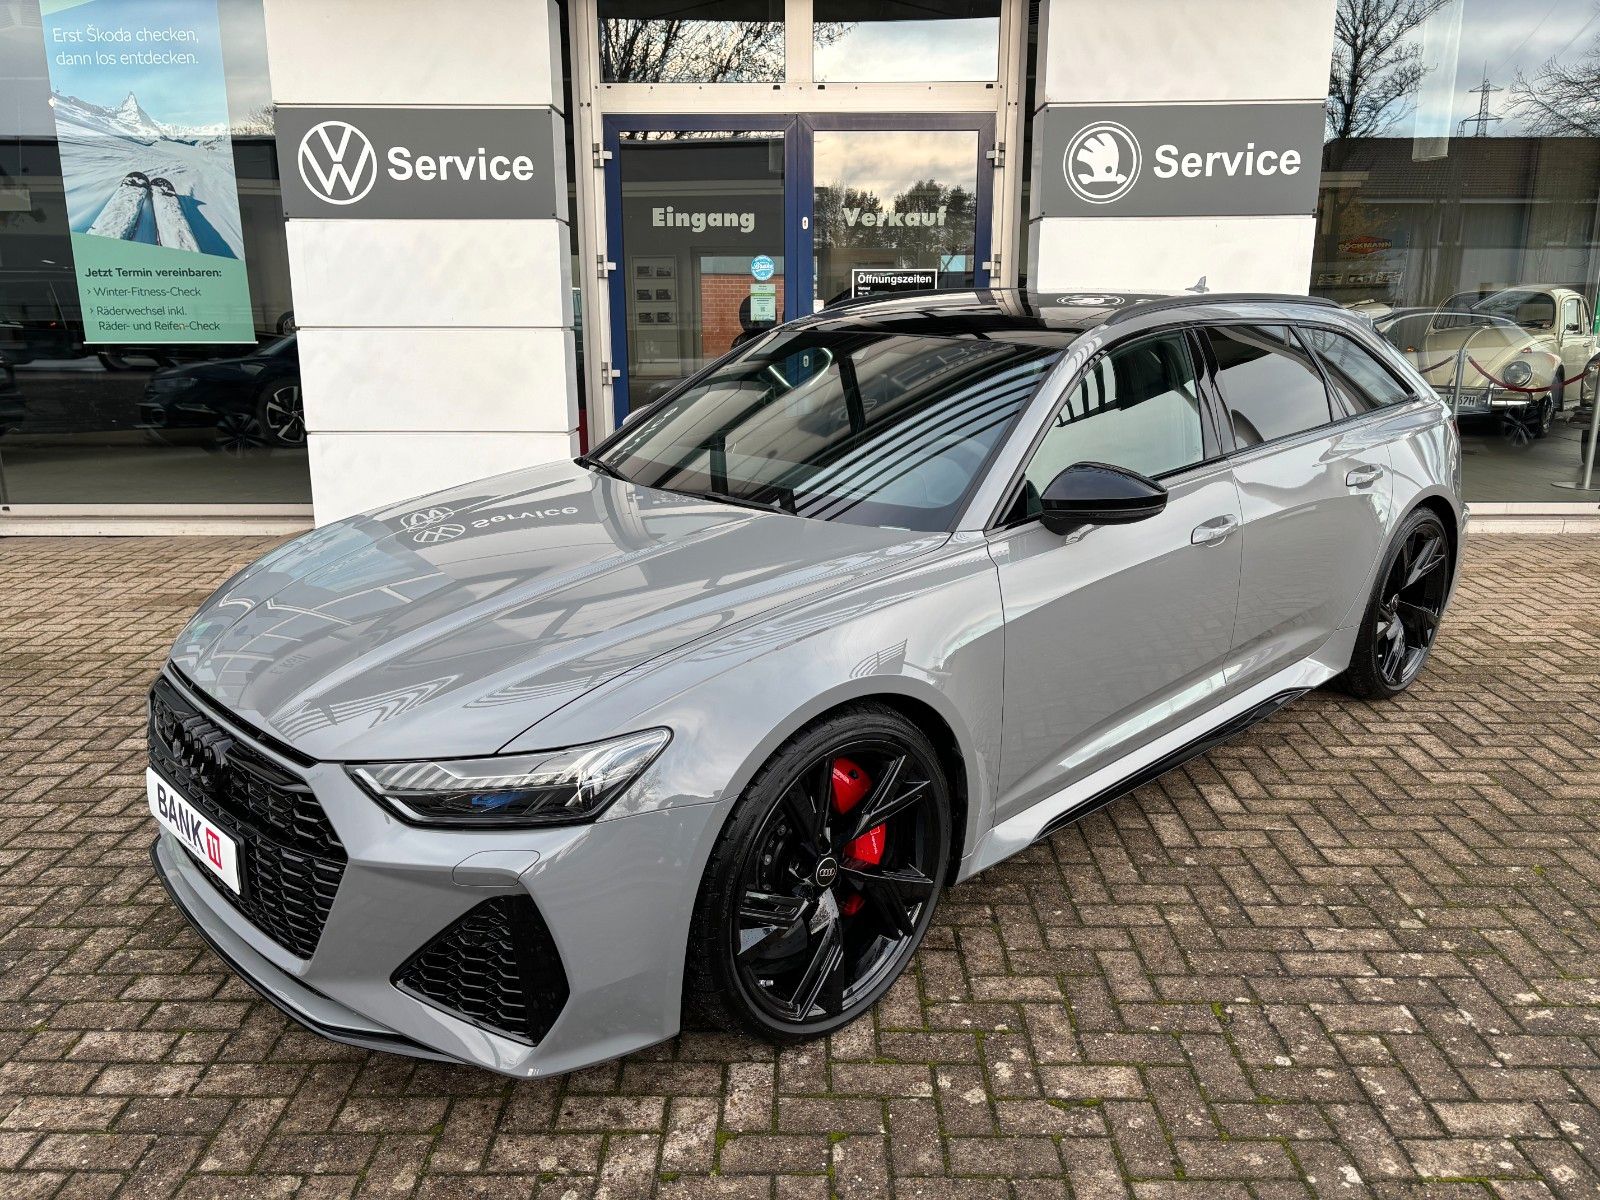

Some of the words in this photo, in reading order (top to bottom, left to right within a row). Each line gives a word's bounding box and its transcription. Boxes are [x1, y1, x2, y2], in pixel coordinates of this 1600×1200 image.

[53, 27, 83, 43] Erst
[86, 24, 132, 42] Škoda
[136, 27, 199, 44] checken,
[56, 52, 92, 65] dann
[96, 51, 116, 65] los
[120, 51, 199, 65] entdecken.
[387, 146, 534, 181] Service
[1153, 142, 1301, 179] Service
[652, 206, 755, 233] Eingang
[842, 206, 947, 228] Verkauf
[85, 268, 113, 277] Jetzt
[115, 268, 152, 277] Termin
[155, 268, 222, 277] vereinbaren:
[858, 272, 932, 286] Öffnungszeiten
[94, 287, 201, 297] Winter-Fitness-Check
[96, 306, 165, 316] Räderwechsel
[168, 306, 187, 316] inkl.
[99, 321, 130, 331] Räder-
[133, 321, 151, 331] und
[155, 321, 220, 331] Reifen-Check
[157, 782, 206, 855] BANK
